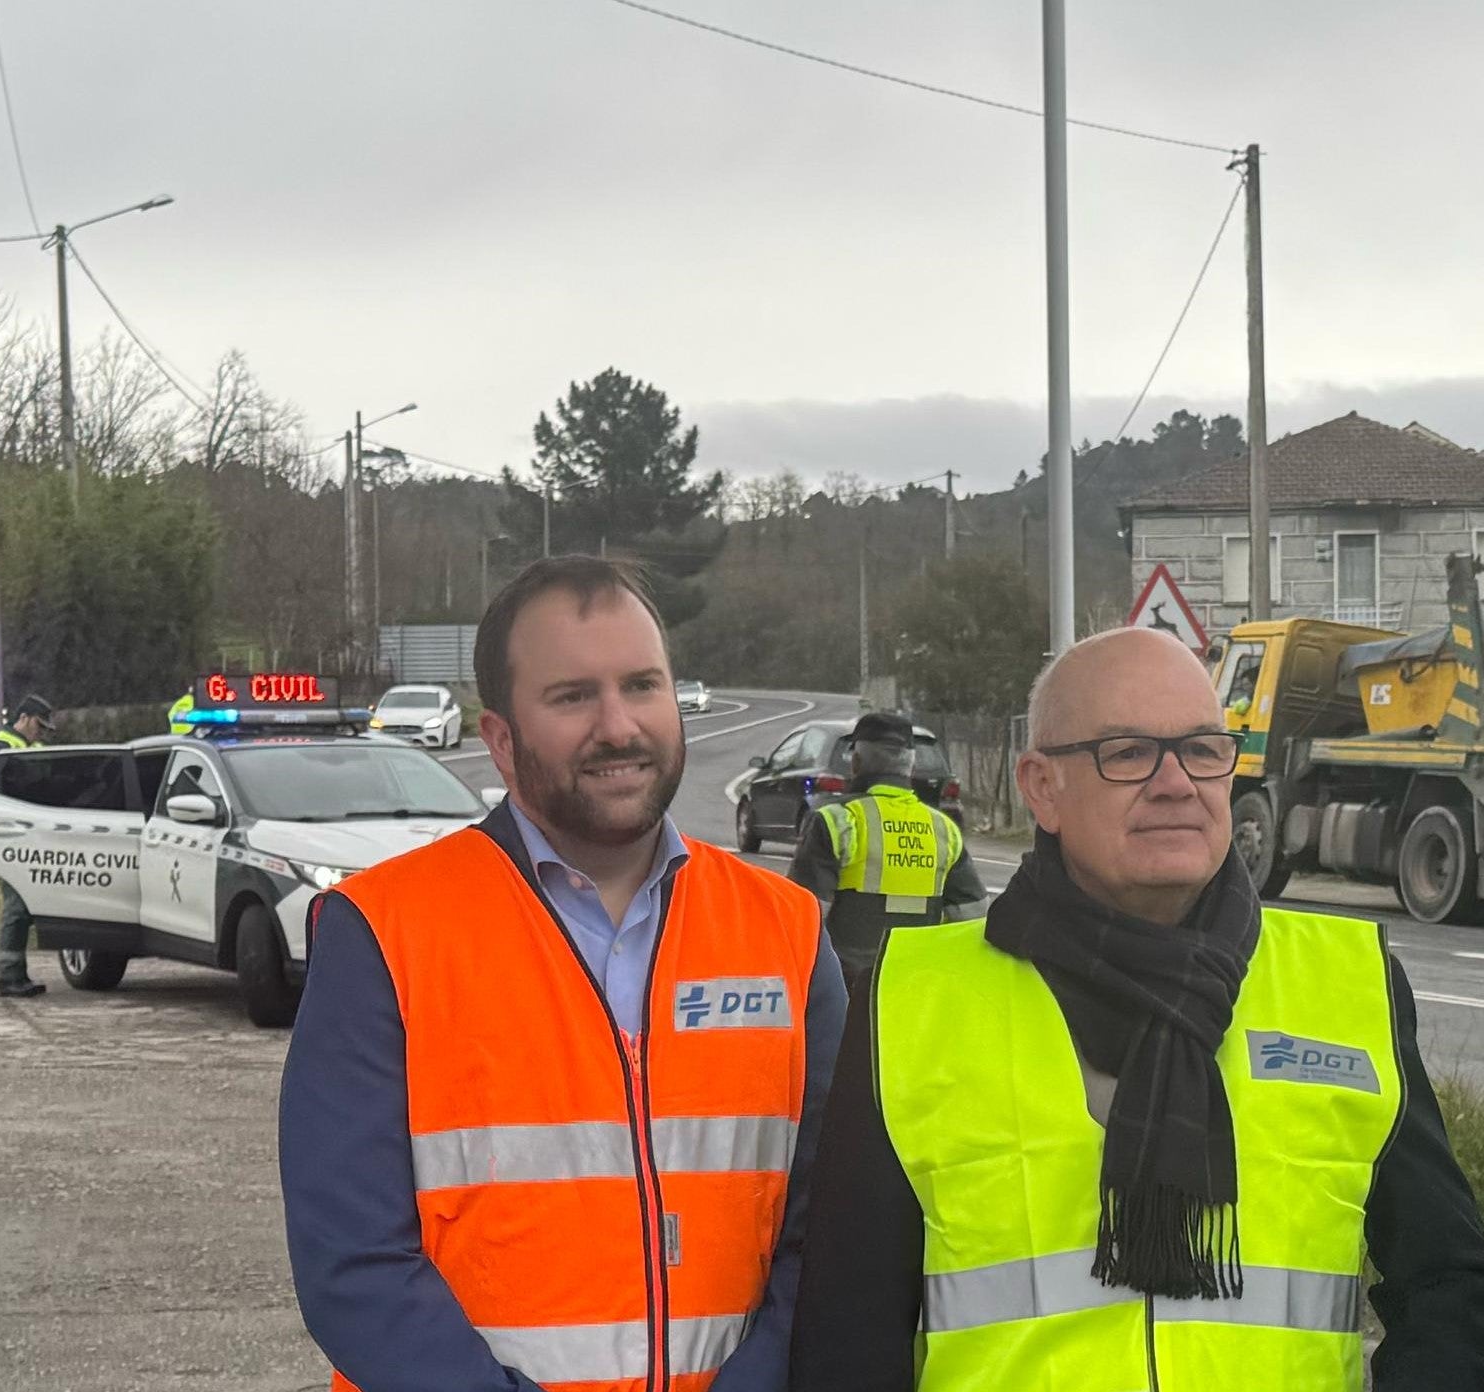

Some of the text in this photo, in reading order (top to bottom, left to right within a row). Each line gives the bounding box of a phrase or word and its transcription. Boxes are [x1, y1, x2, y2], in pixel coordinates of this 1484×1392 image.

[207, 673, 325, 702] G. CIVIL
[883, 820, 933, 835] GUARDIA
[898, 835, 925, 849] CIVIL
[2, 847, 140, 870] GUARDIA CIVIL
[887, 850, 935, 868] TRÁFICO
[29, 867, 112, 887] TRÁFICO
[720, 991, 784, 1014] DGT
[1301, 1049, 1362, 1071] DGT
